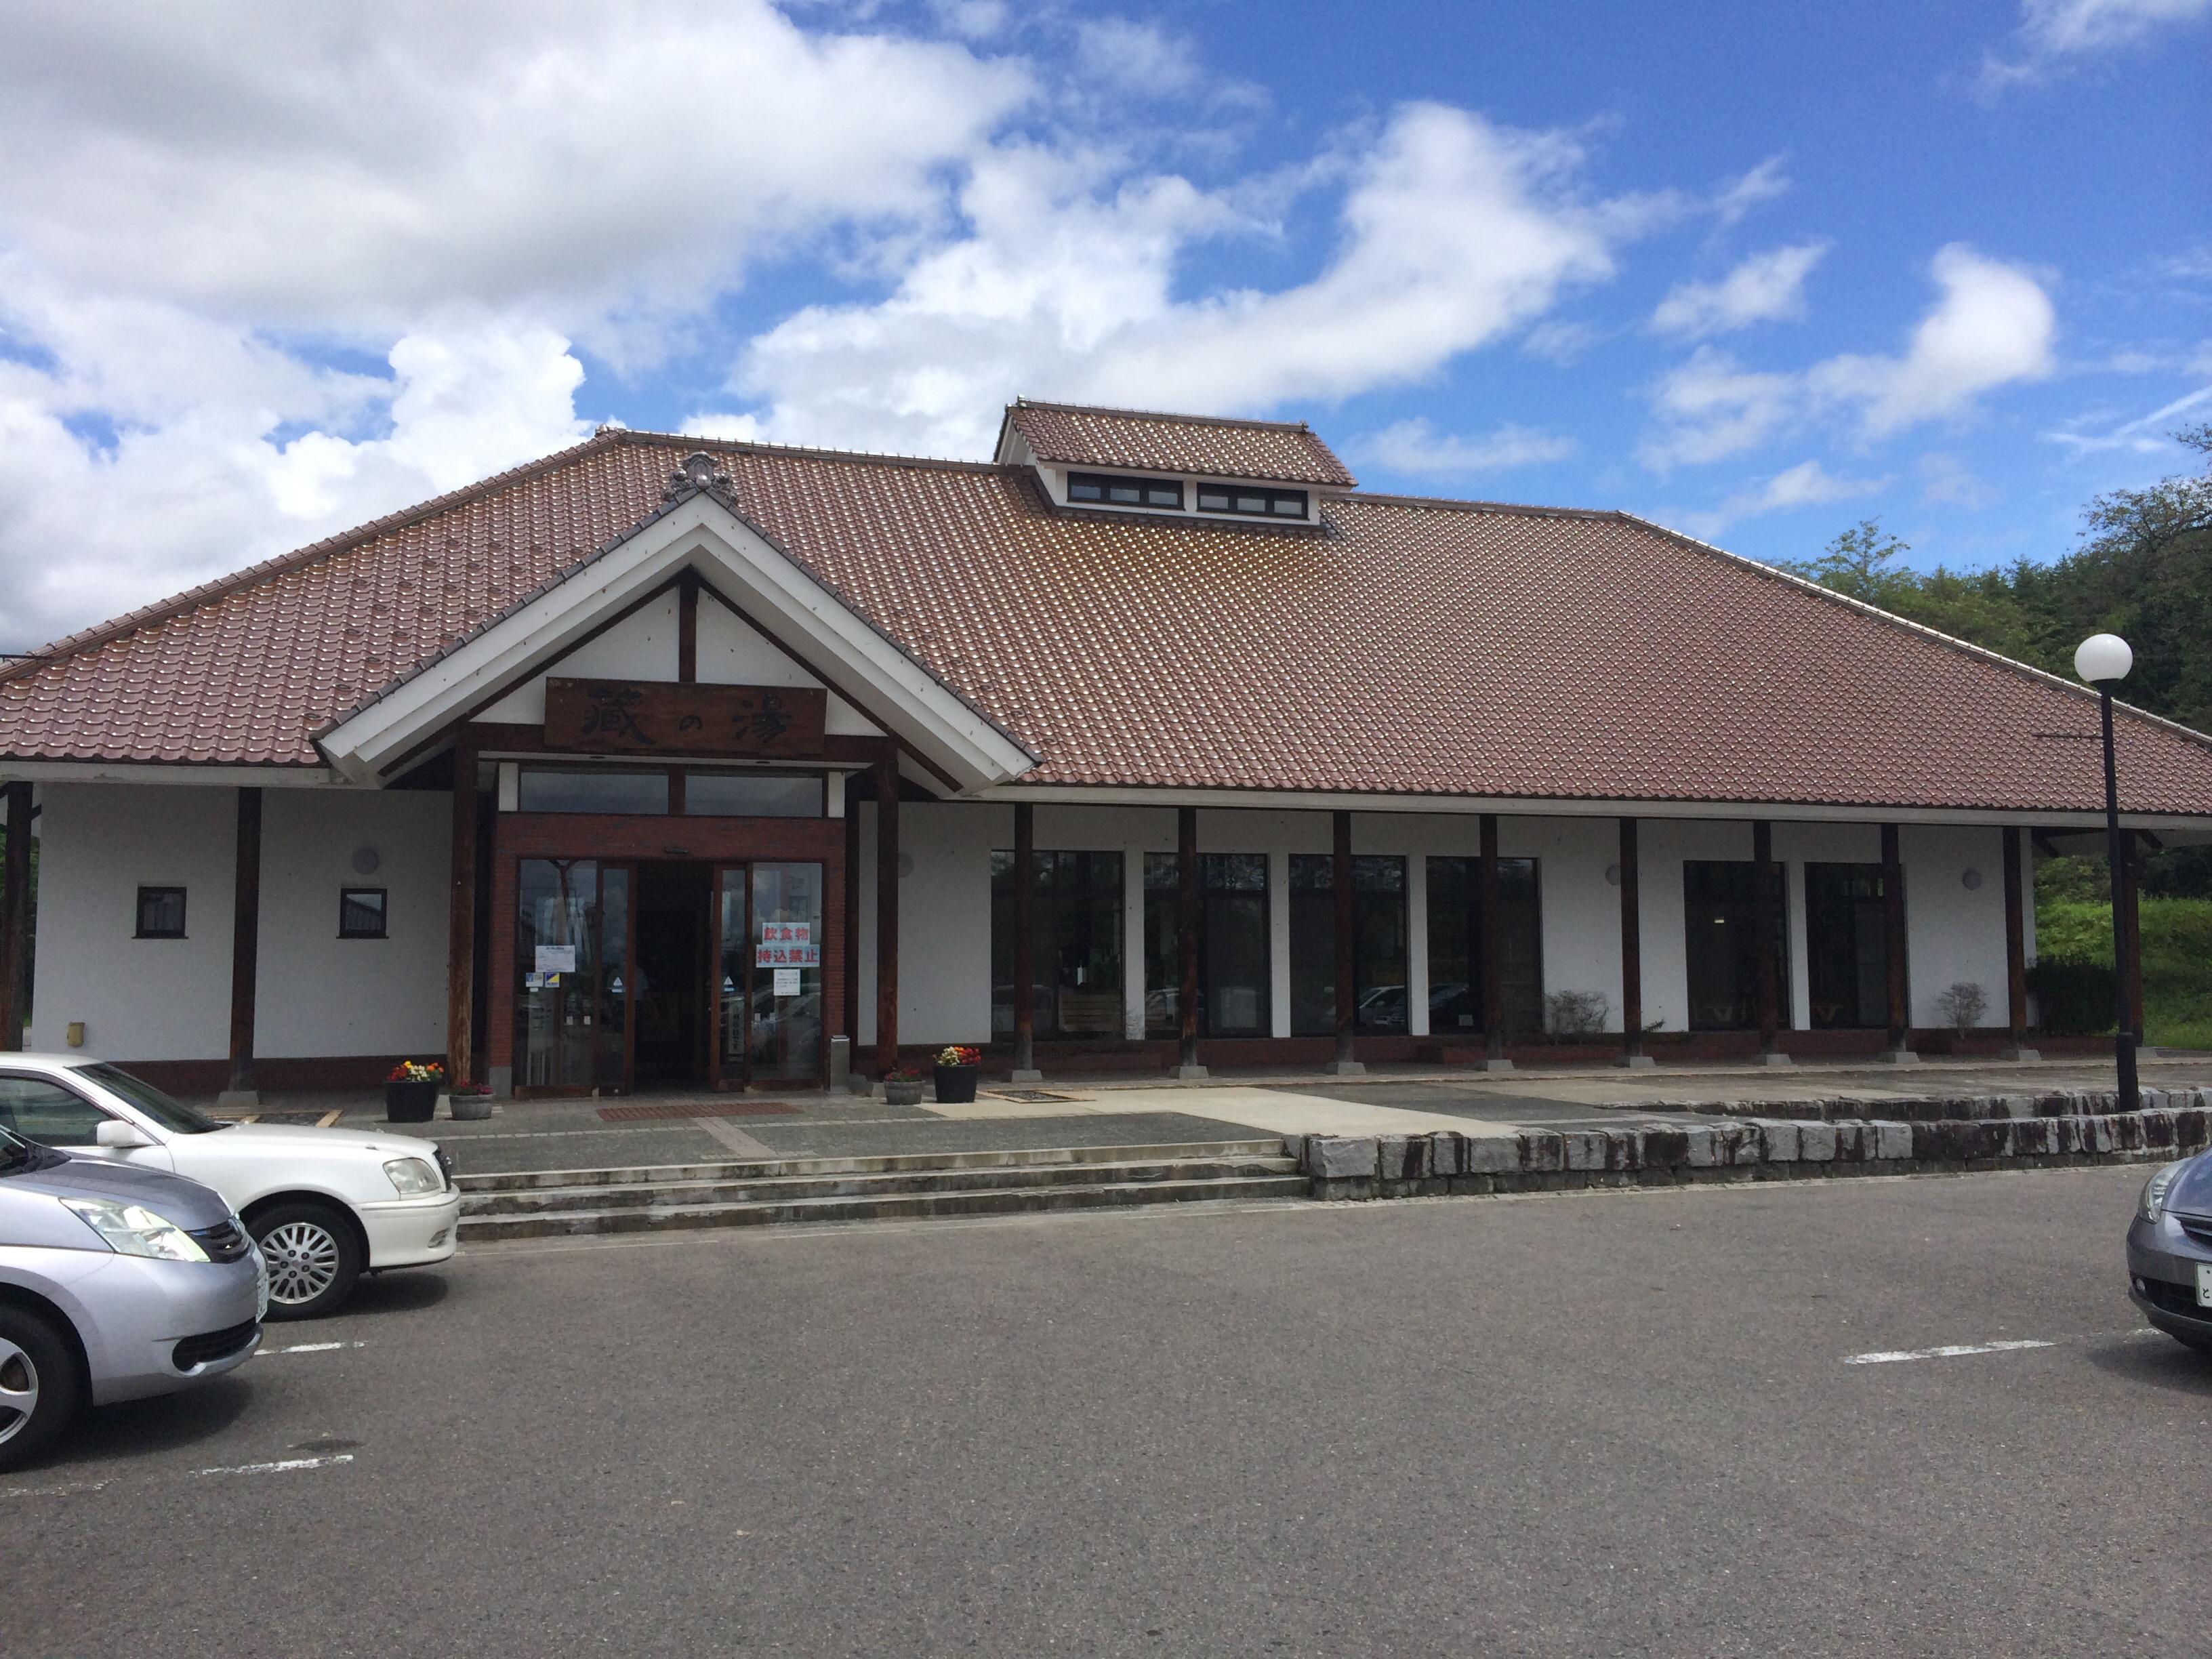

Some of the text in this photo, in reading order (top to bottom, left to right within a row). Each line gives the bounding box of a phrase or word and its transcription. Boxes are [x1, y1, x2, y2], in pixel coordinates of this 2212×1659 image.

[581, 685, 793, 745] 蔵の湯
[764, 926, 809, 941] 飲食物
[758, 949, 819, 964] 持込禁止
[2202, 1287, 2211, 1299] と
